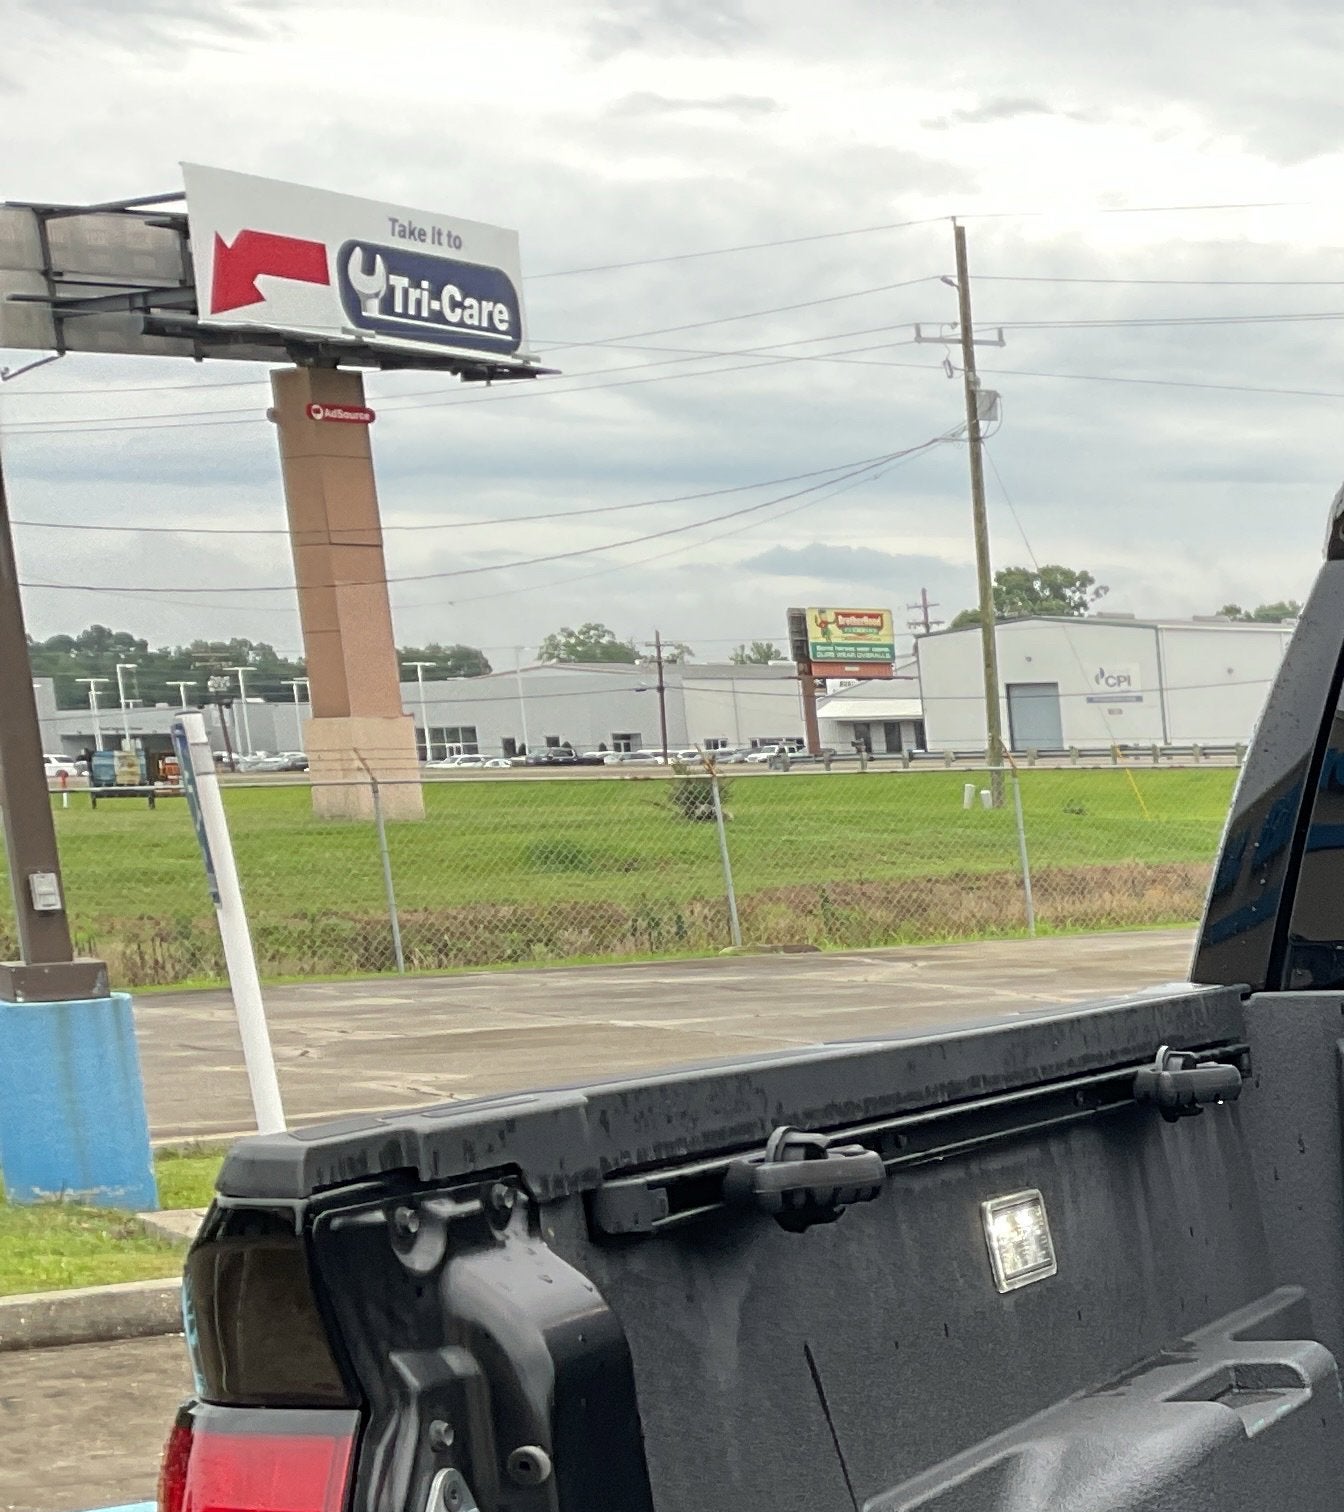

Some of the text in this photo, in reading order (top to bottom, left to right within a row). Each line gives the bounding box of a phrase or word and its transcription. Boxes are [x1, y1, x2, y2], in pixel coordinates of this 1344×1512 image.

[388, 217, 462, 250] Take It to
[388, 274, 510, 332] Tri-Care
[324, 408, 371, 421] AdSource
[1105, 674, 1132, 688] CPI
